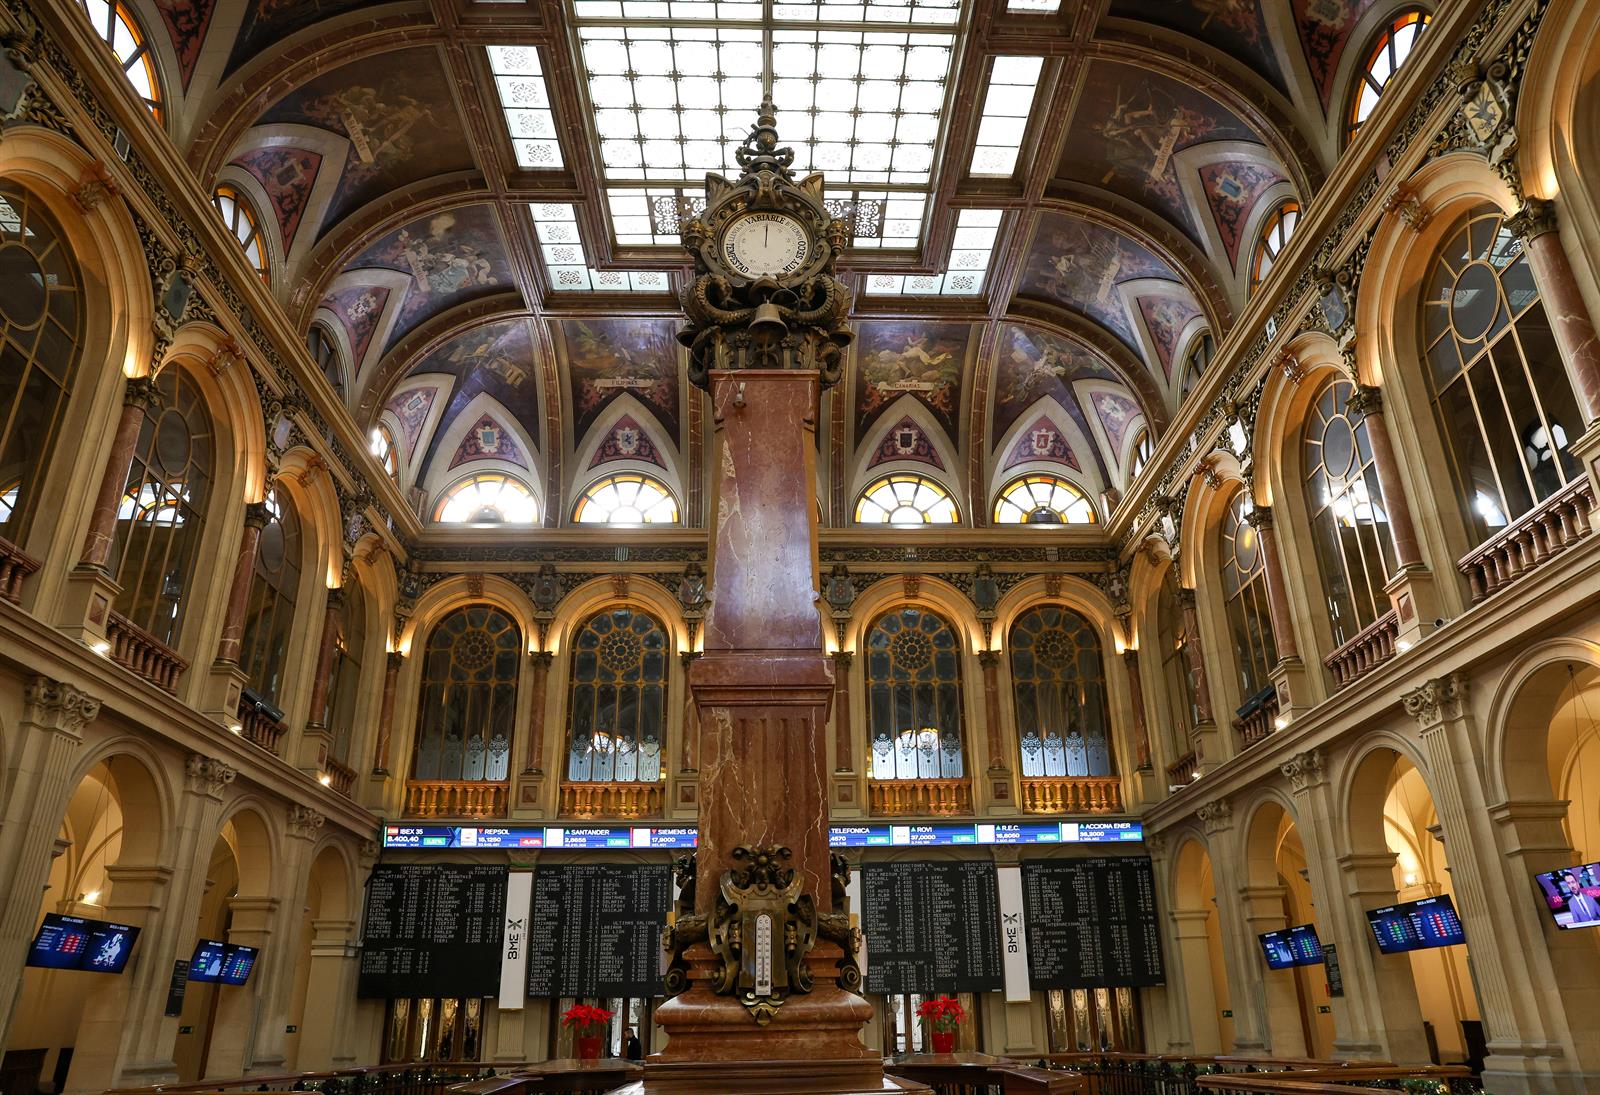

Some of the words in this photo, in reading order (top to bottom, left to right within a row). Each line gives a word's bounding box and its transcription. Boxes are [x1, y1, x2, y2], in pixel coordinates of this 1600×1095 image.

[745, 214, 786, 225] VARIABLE
[725, 243, 750, 274] TEMPESTAD
[782, 259, 800, 273] MUY
[795, 240, 807, 260] SECO
[507, 933, 519, 960] BME
[1006, 927, 1018, 953] BME
